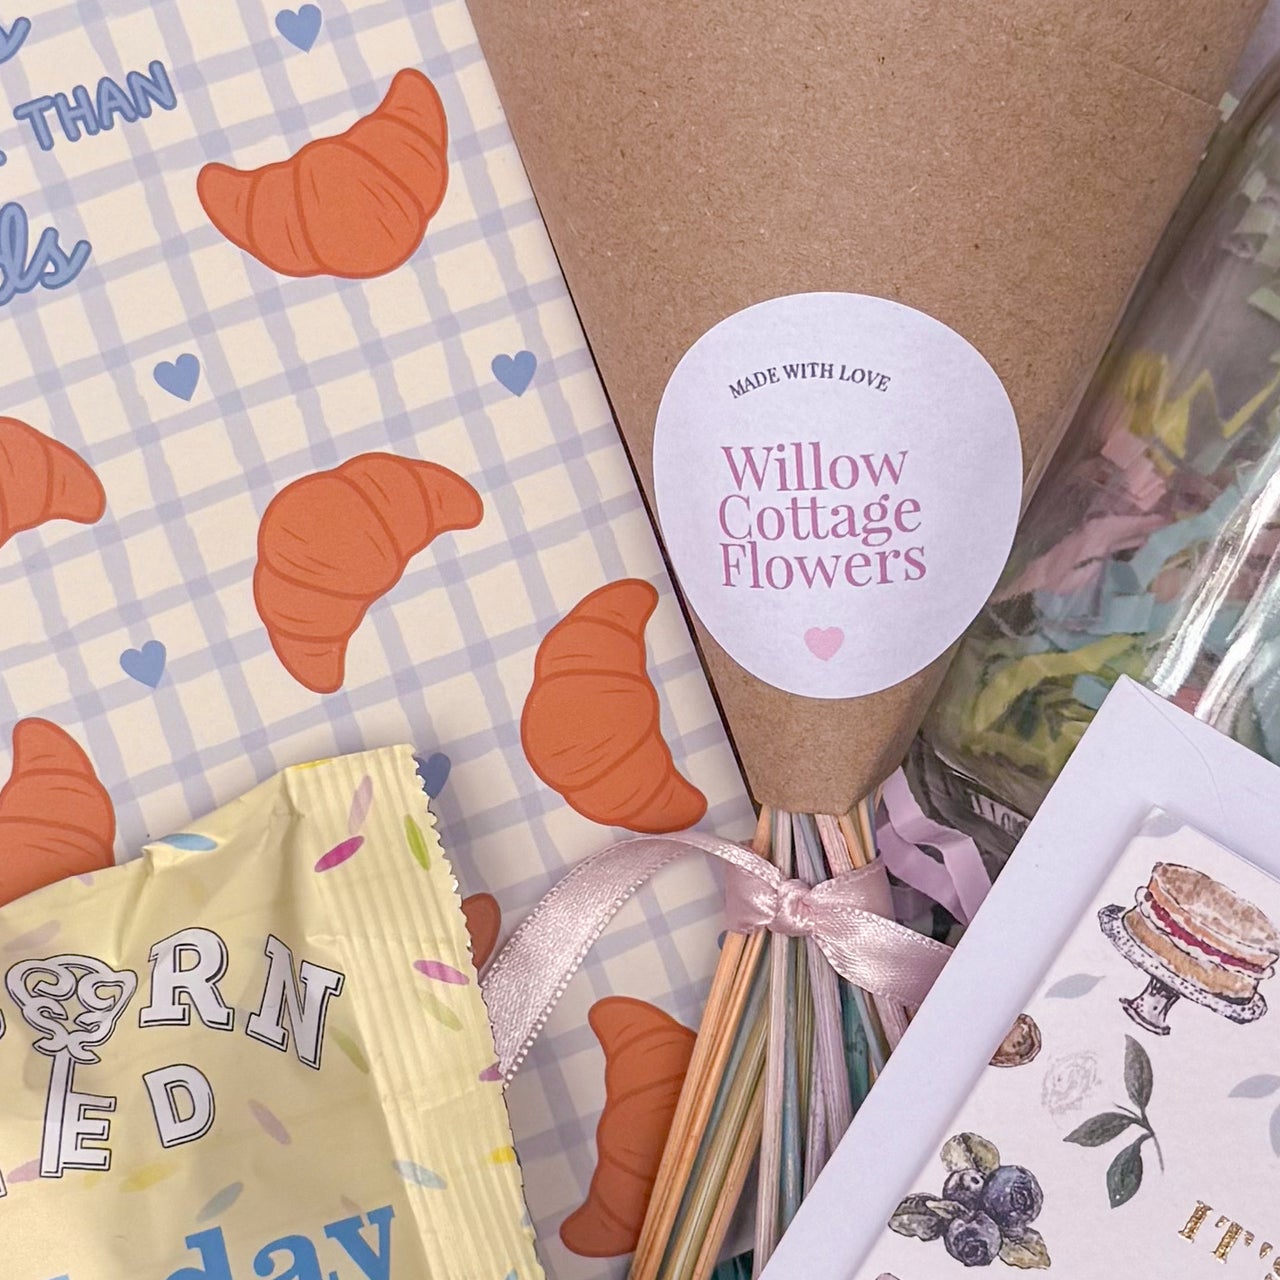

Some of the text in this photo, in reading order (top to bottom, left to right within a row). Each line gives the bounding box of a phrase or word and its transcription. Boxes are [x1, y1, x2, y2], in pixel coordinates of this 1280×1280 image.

[14, 61, 178, 151] THAN
[728, 362, 891, 399] MADE WITH LOVE
[721, 442, 909, 491] Willow
[719, 494, 922, 547] Cottage
[720, 541, 927, 590] Flowers
